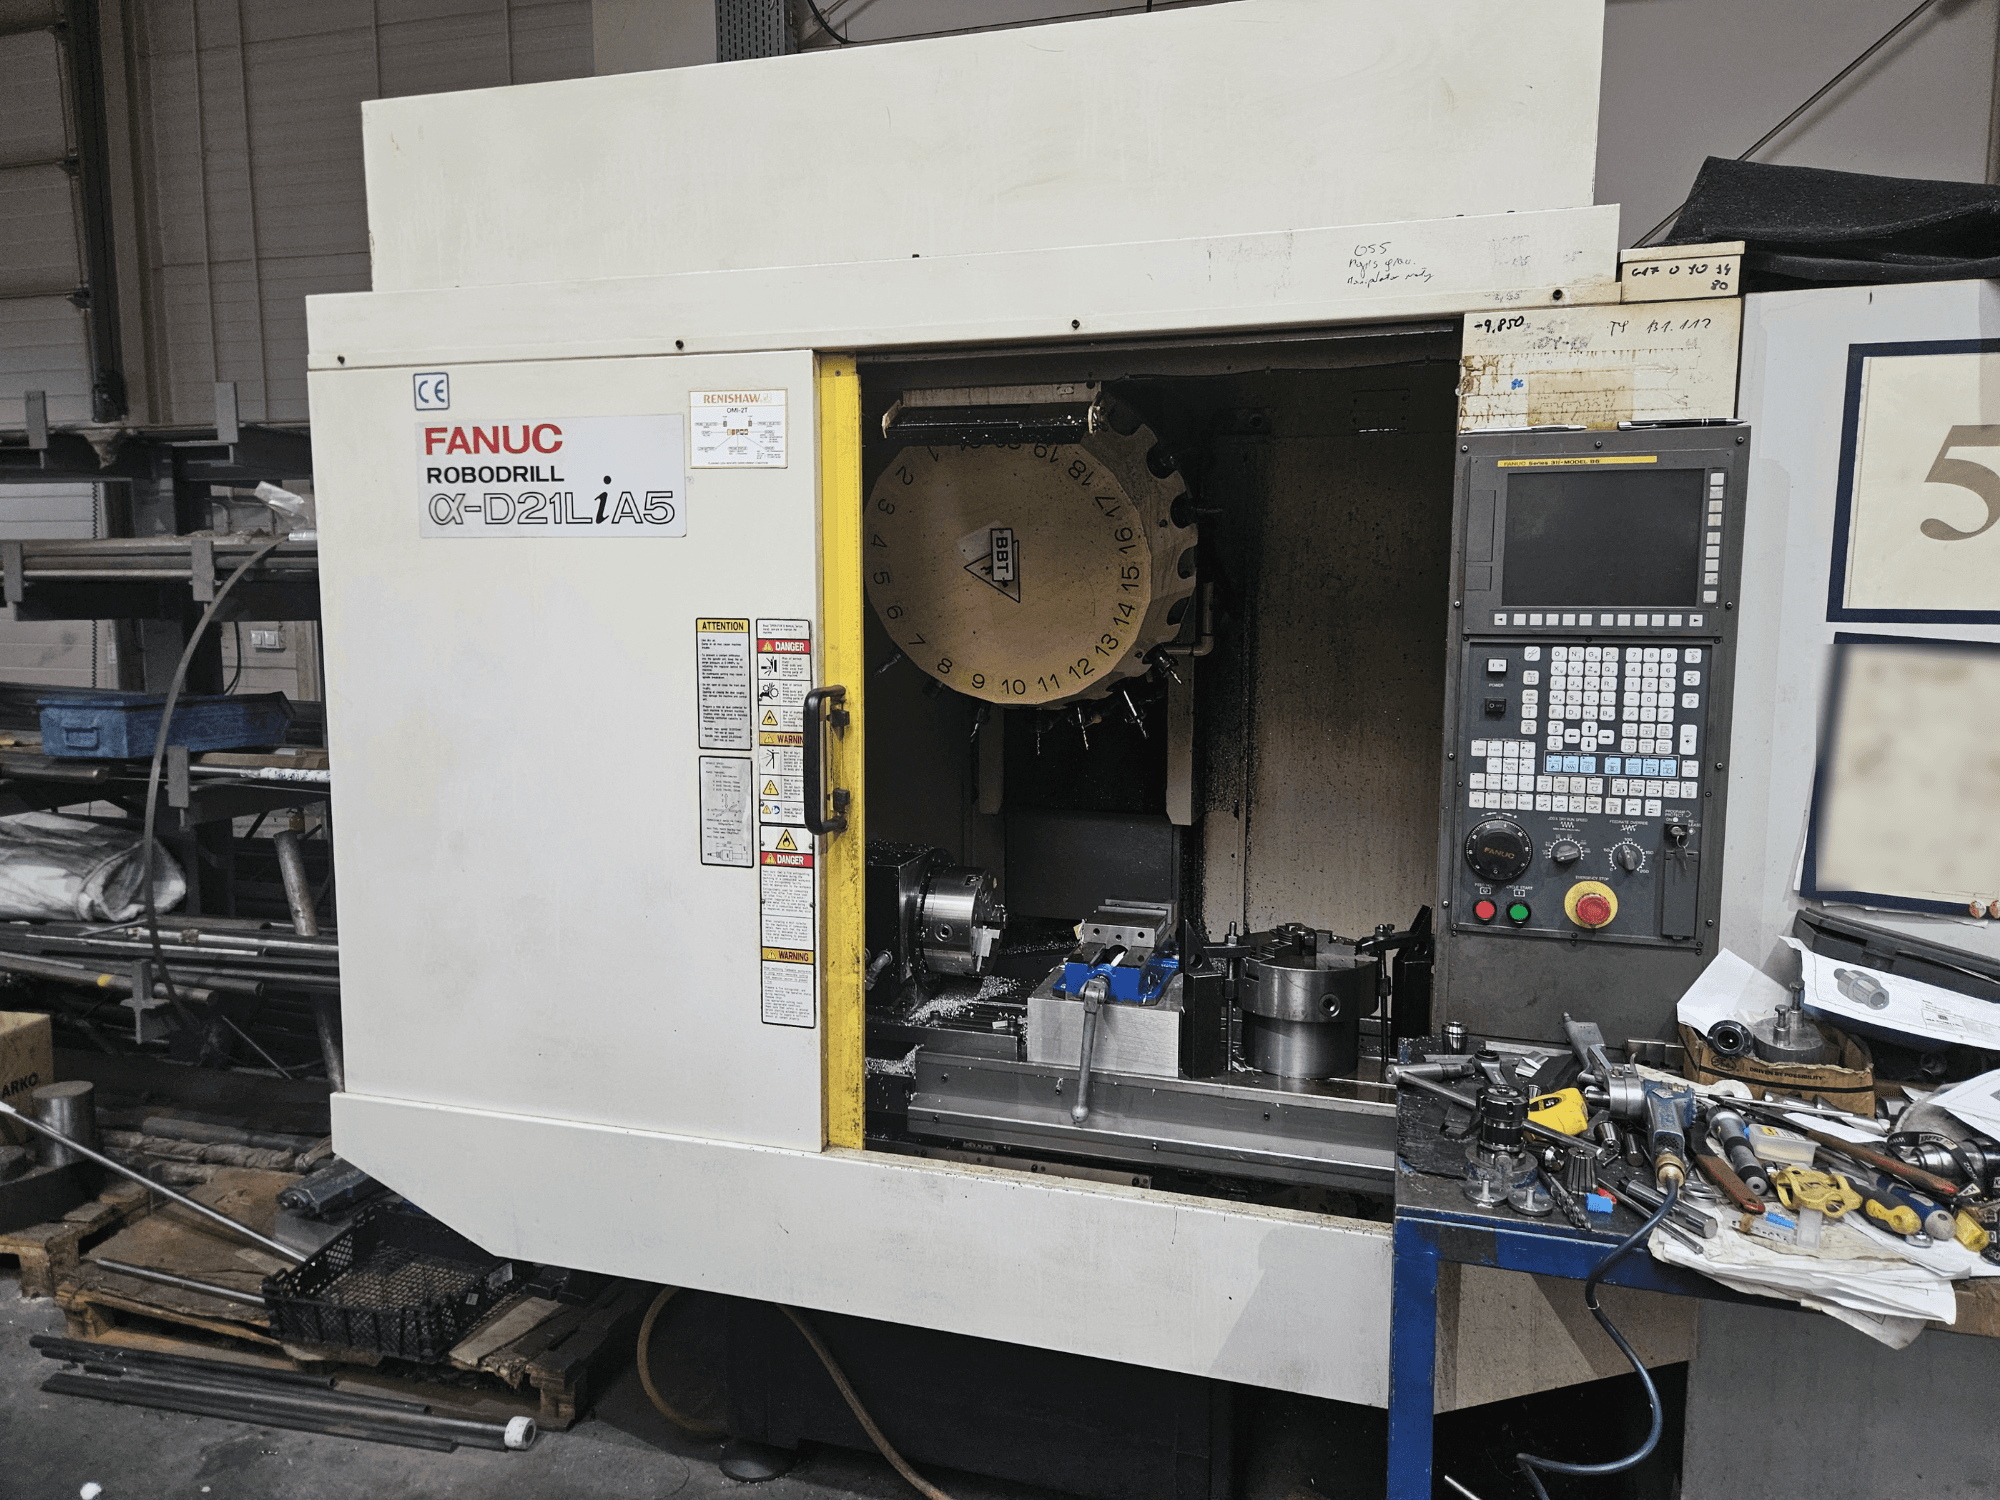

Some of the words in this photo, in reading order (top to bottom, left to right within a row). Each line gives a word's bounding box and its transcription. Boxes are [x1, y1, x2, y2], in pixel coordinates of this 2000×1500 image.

[703, 393, 761, 404] RENISHAW
[425, 423, 563, 456] FANUC
[427, 465, 565, 484] ROBODRILL
[895, 465, 914, 486] 2
[1067, 460, 1093, 487] 18
[1919, 423, 2000, 542] 5
[877, 499, 895, 515] 3
[1094, 494, 1121, 518] 17
[870, 533, 888, 550] 4
[1114, 526, 1136, 554] 16
[996, 536, 1010, 574] BBT
[873, 570, 891, 586] 5
[1121, 565, 1140, 588] 15
[887, 604, 903, 620] 6
[1113, 602, 1136, 626] 14
[701, 621, 744, 631] ATTENTION
[775, 641, 805, 652] DANGER
[908, 632, 927, 647] 7
[1095, 633, 1119, 657] 13
[937, 657, 953, 675] 8
[1069, 657, 1096, 680] 12
[971, 673, 985, 689] 9
[1001, 678, 1026, 695] 10
[1037, 673, 1061, 692] 11
[777, 854, 804, 865] DANGER
[1483, 846, 1516, 860] FANUC
[778, 950, 809, 962] WARNING
[1749, 1066, 1774, 1076] DRIVEN
